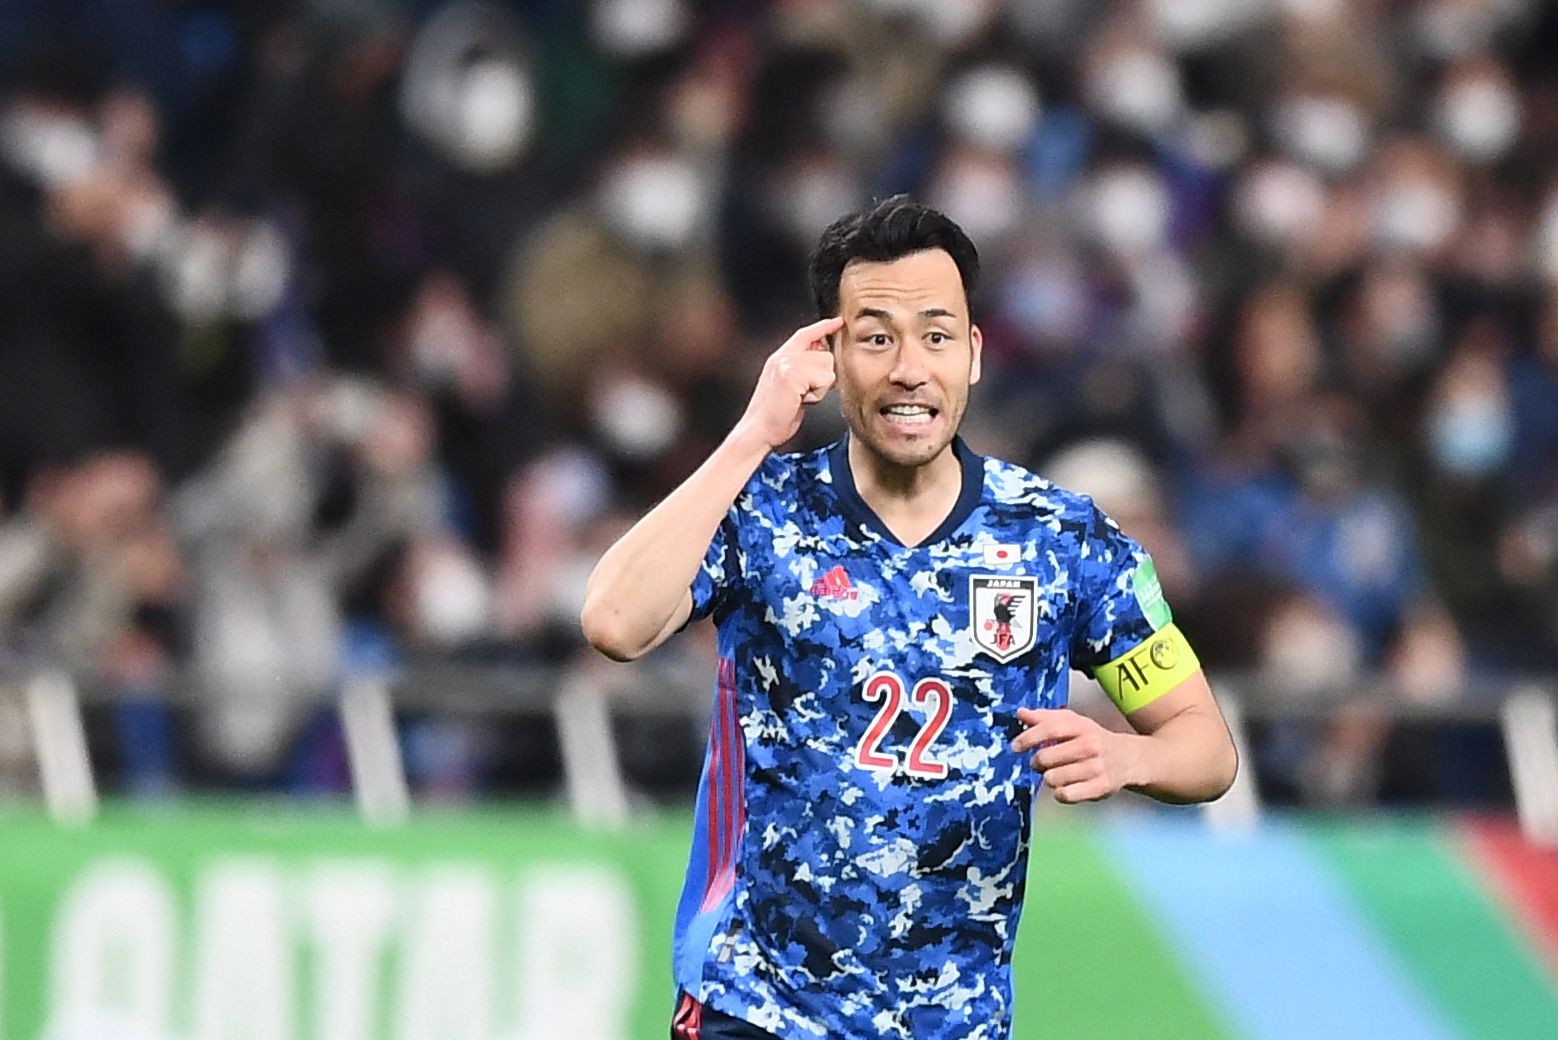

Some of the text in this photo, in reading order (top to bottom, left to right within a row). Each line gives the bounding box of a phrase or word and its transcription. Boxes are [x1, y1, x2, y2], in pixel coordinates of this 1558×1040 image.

[986, 579, 1021, 588] JAPAN
[990, 632, 1016, 646] JFA
[1115, 637, 1180, 701] AFC
[855, 670, 954, 780] 22
